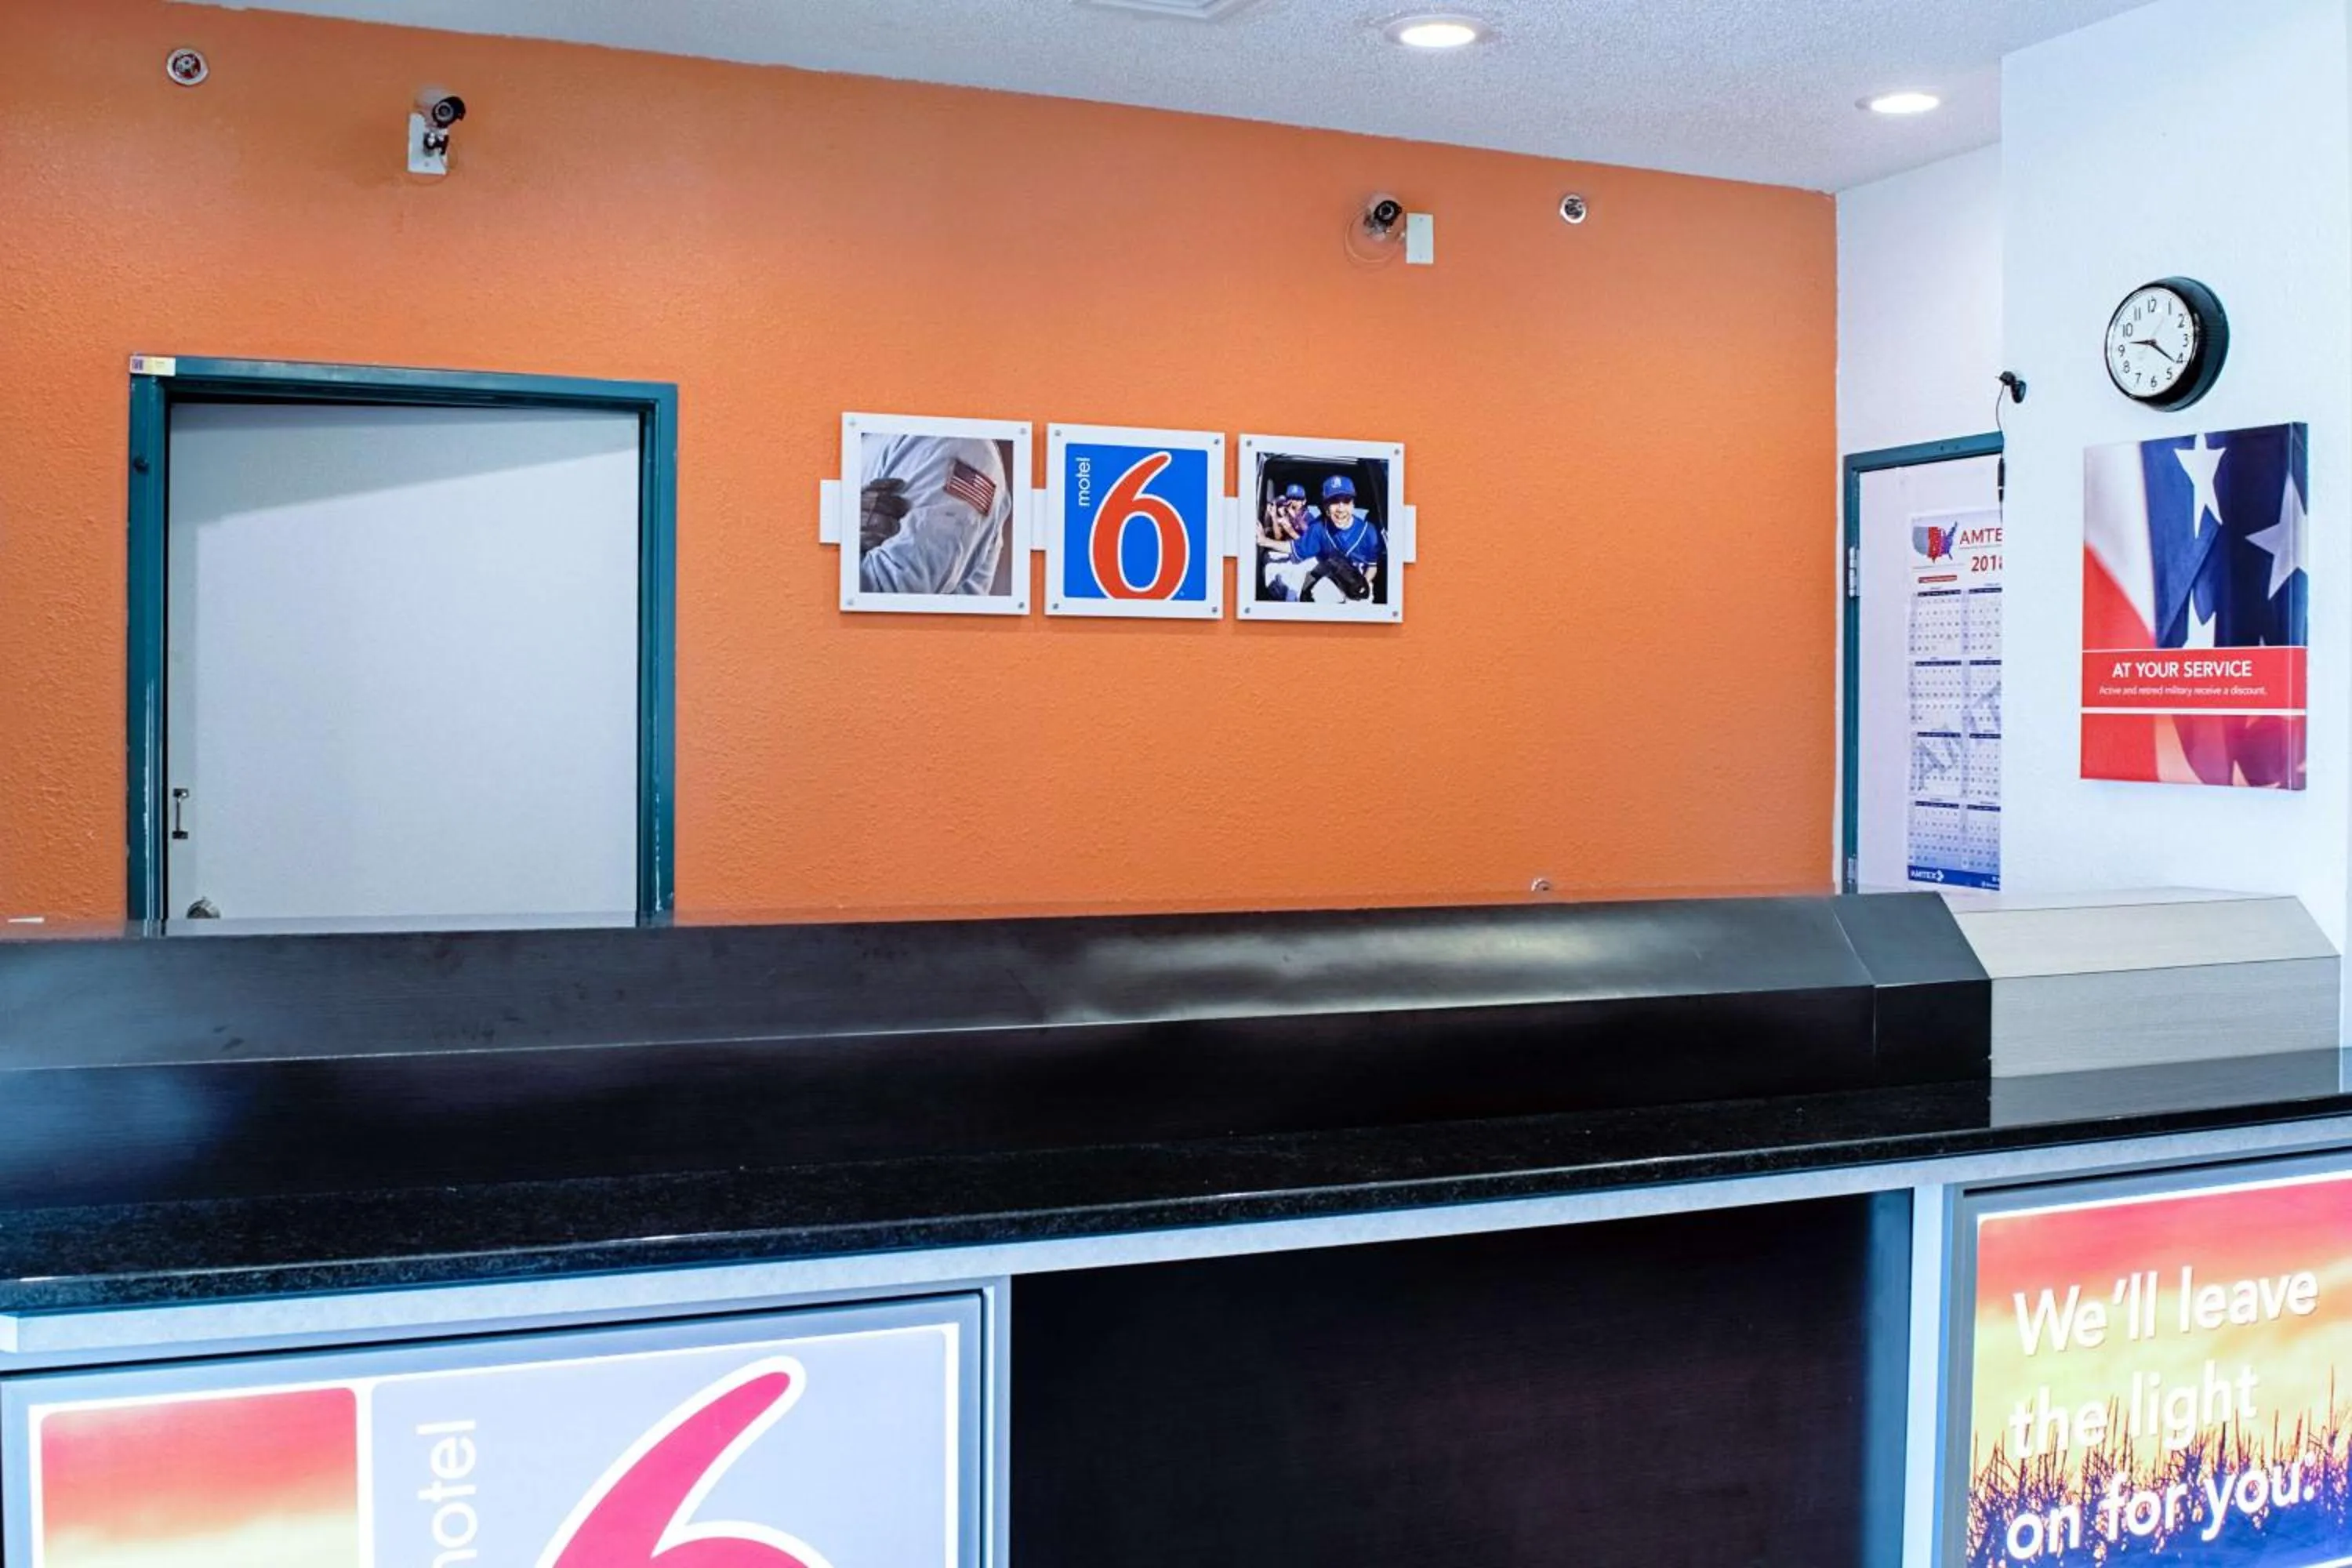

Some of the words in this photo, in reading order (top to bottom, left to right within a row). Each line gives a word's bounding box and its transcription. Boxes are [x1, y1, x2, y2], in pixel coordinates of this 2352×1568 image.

[2147, 297, 2157, 313] 12
[2167, 299, 2172, 315] 1
[2134, 307, 2141, 321] 11
[2177, 314, 2185, 328] 2
[2122, 322, 2133, 337] 10
[2182, 334, 2189, 347] 3
[2118, 345, 2125, 358] 9
[2176, 353, 2183, 364] 4
[2123, 361, 2130, 374] 8
[2166, 368, 2172, 380] 5
[2135, 372, 2142, 384] 7
[2151, 376, 2157, 388] 6
[1076, 457, 1091, 507] motel
[1088, 451, 1190, 601] 6
[2112, 662, 2132, 678] AT
[2135, 662, 2179, 678] YOUR
[2183, 660, 2252, 678] SERVICE
[2099, 685, 2122, 695] Active
[2122, 685, 2137, 695] and
[2139, 684, 2163, 695] retired
[2165, 684, 2192, 696] military
[2194, 685, 2222, 695] receive
[2230, 684, 2267, 695] discount.
[2013, 1271, 2158, 1356] We'll
[2180, 1265, 2318, 1333] leave
[2009, 1386, 2107, 1458] the
[2130, 1359, 2258, 1450] light
[2006, 1503, 2080, 1559] on
[2100, 1471, 2187, 1543] for
